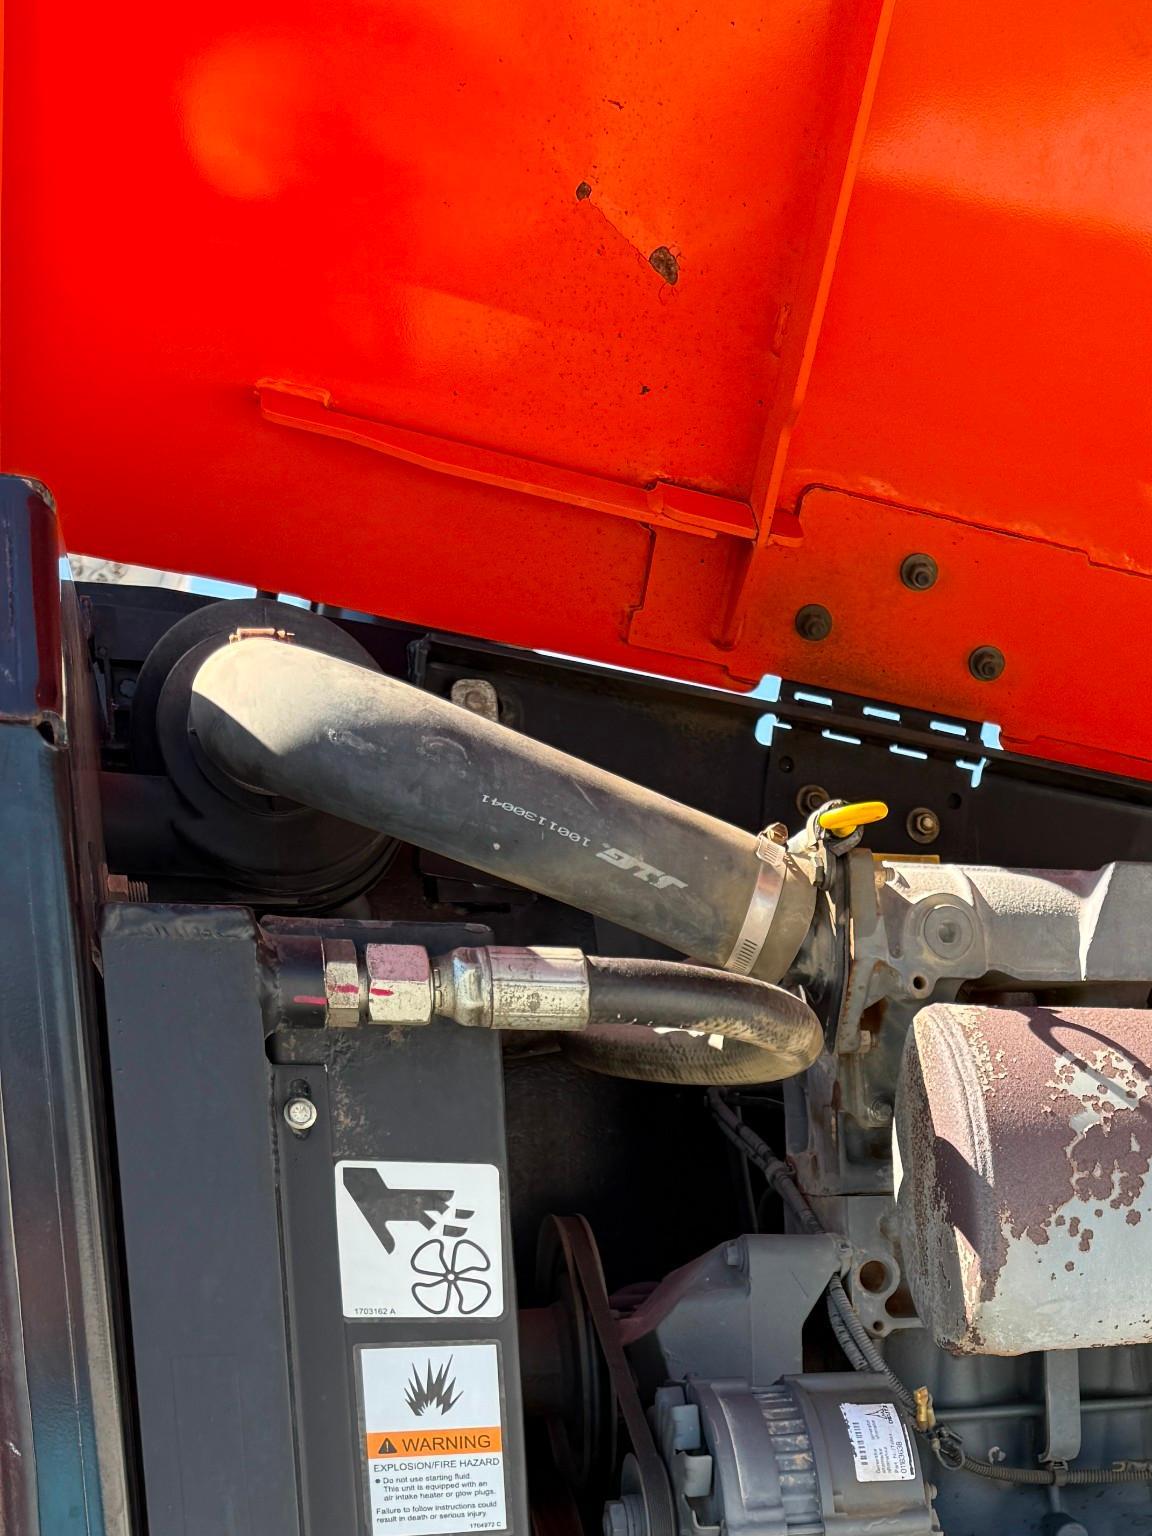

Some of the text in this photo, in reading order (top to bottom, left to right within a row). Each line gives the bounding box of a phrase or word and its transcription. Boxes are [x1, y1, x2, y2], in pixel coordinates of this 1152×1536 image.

[481, 794, 688, 889] JLG 1001130041
[402, 1435, 491, 1452] WARNING
[374, 1458, 500, 1472] EXPLOSION/FIRE HAZARD
[425, 1474, 452, 1482] starting
[425, 1483, 459, 1491] equipped
[420, 1492, 443, 1500] heater
[455, 1490, 472, 1499] glow
[435, 1502, 476, 1510] instructions
[407, 1513, 428, 1521] death
